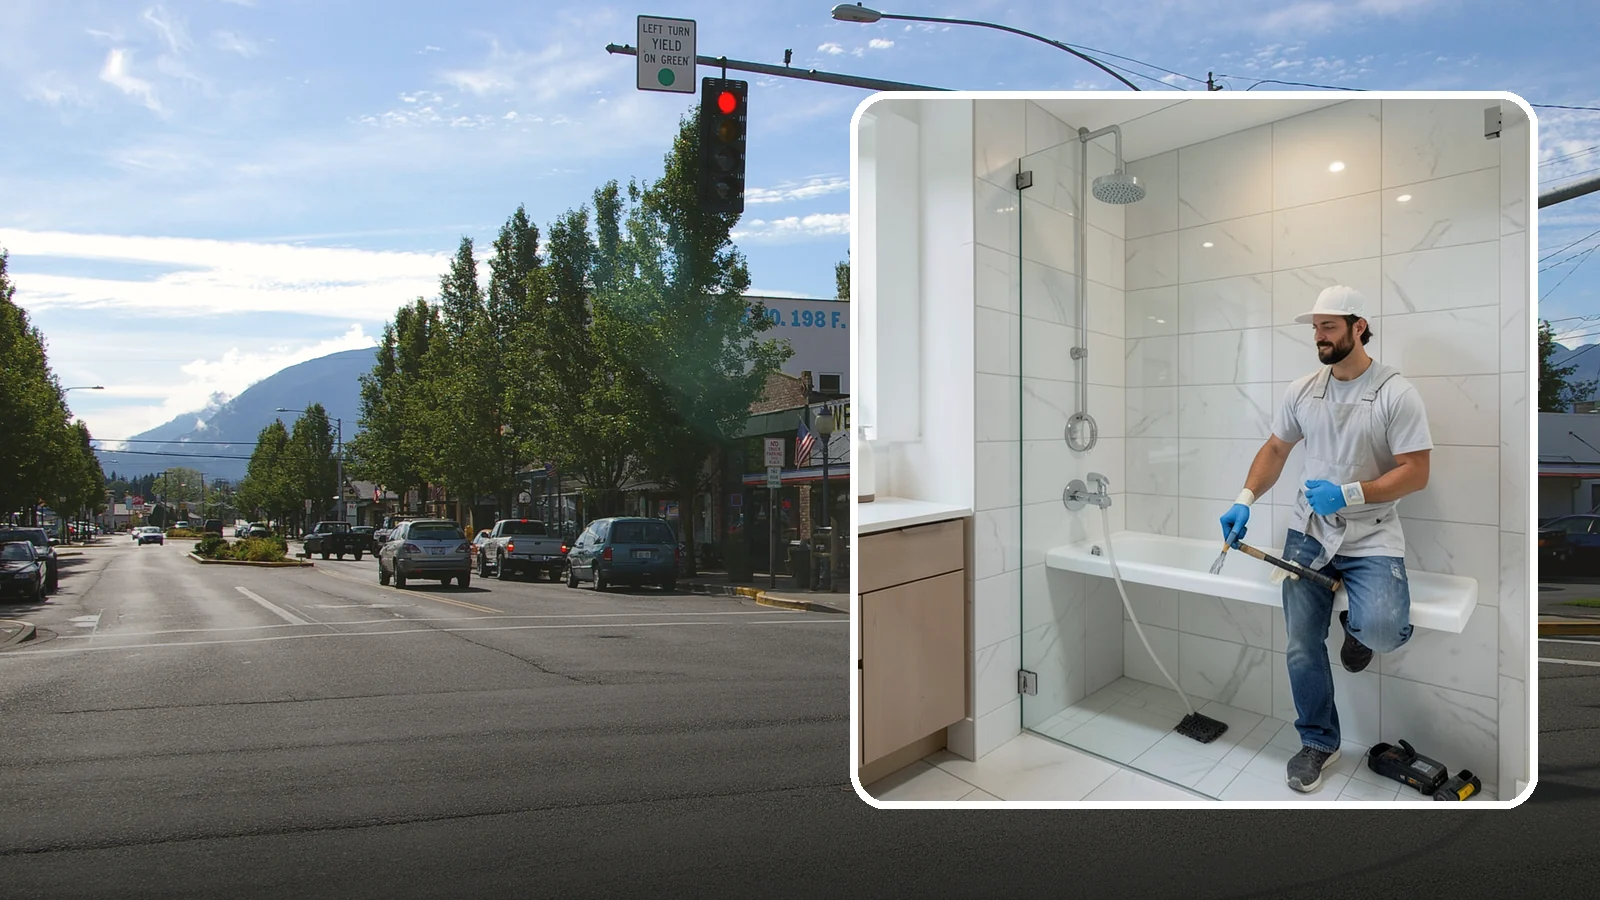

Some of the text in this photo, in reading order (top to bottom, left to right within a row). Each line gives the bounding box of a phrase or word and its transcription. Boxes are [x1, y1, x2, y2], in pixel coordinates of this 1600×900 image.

[642, 23, 690, 37] LEFT TURN
[652, 38, 682, 52] YIELD
[644, 53, 689, 66] ON GREEN
[758, 307, 786, 327] O.
[791, 309, 826, 328] 198
[831, 311, 847, 329] F.
